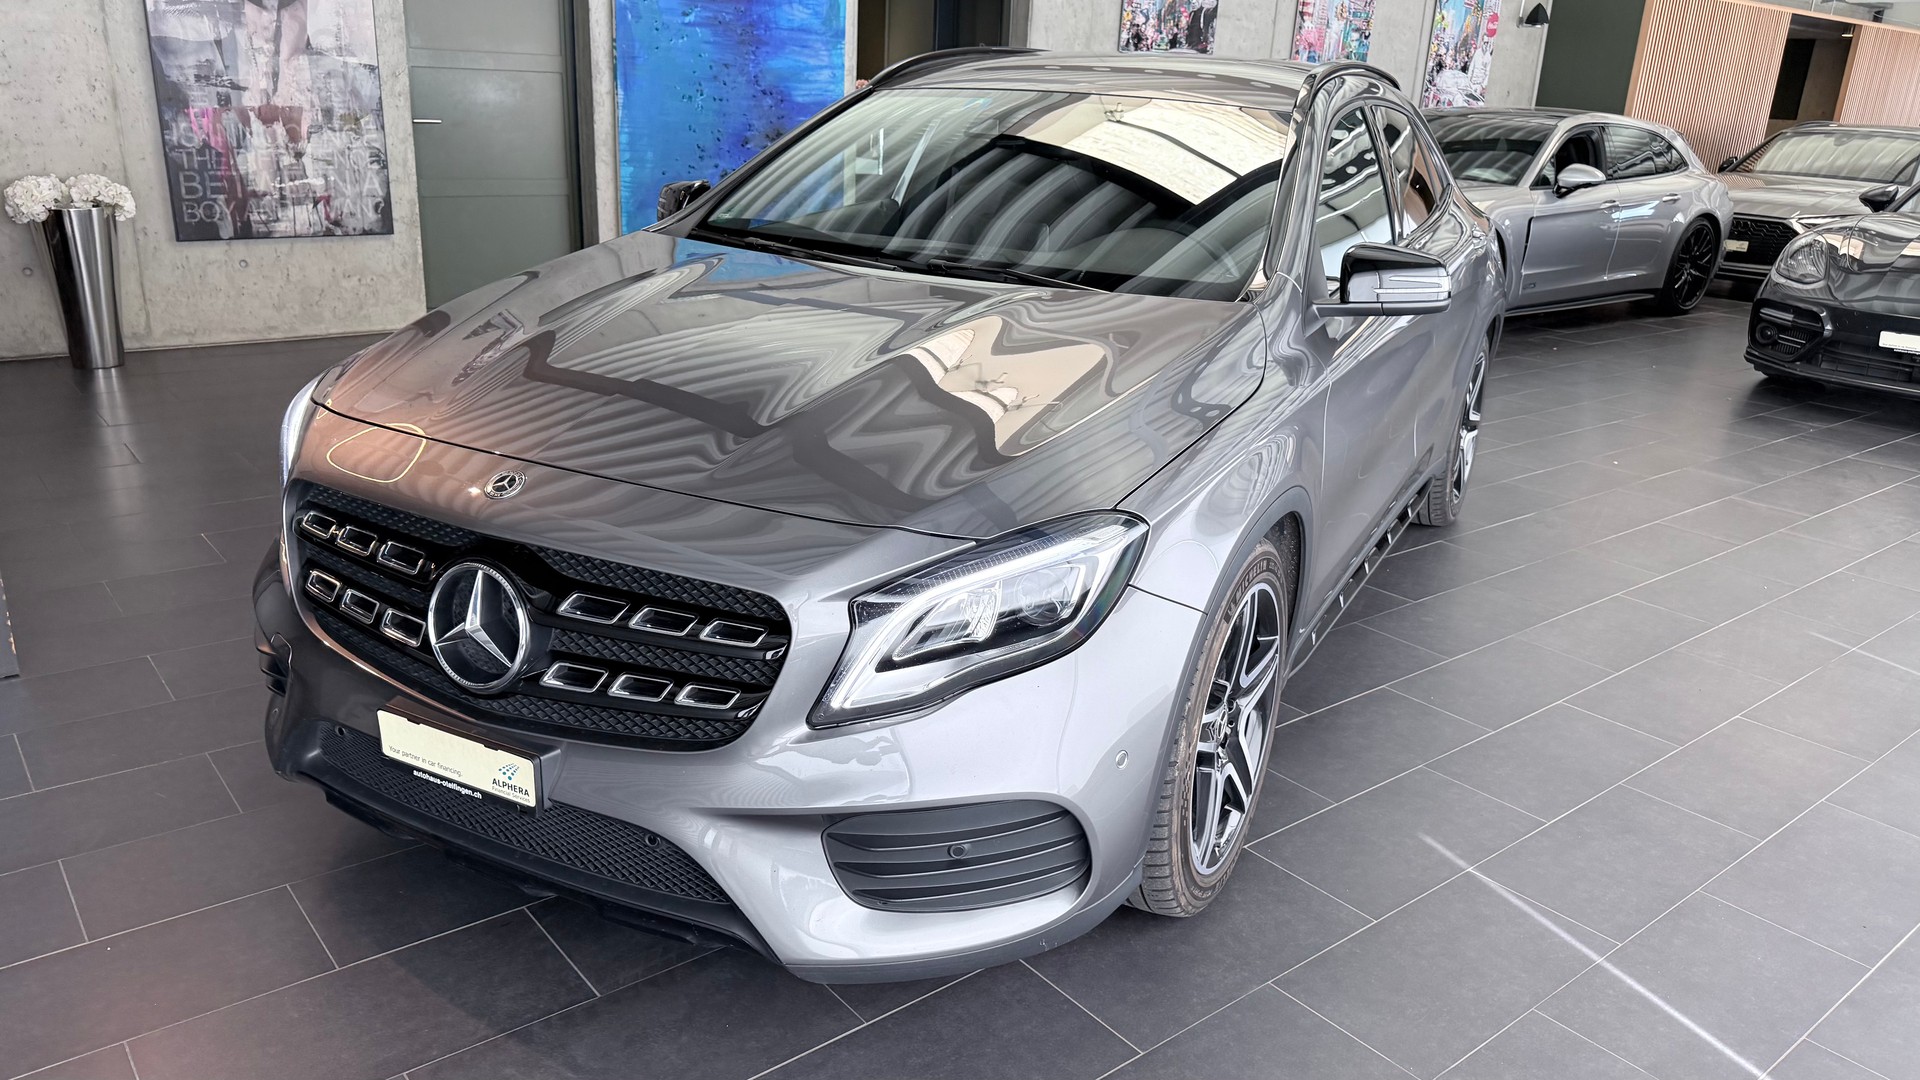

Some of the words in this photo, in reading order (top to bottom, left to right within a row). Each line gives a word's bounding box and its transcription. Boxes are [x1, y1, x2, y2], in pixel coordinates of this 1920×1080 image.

[182, 201, 236, 221] BOY
[388, 745, 401, 755] Your
[401, 750, 421, 762] partner
[491, 786, 512, 797] Financial
[511, 793, 531, 804] Services
[492, 778, 530, 797] ALPHERA
